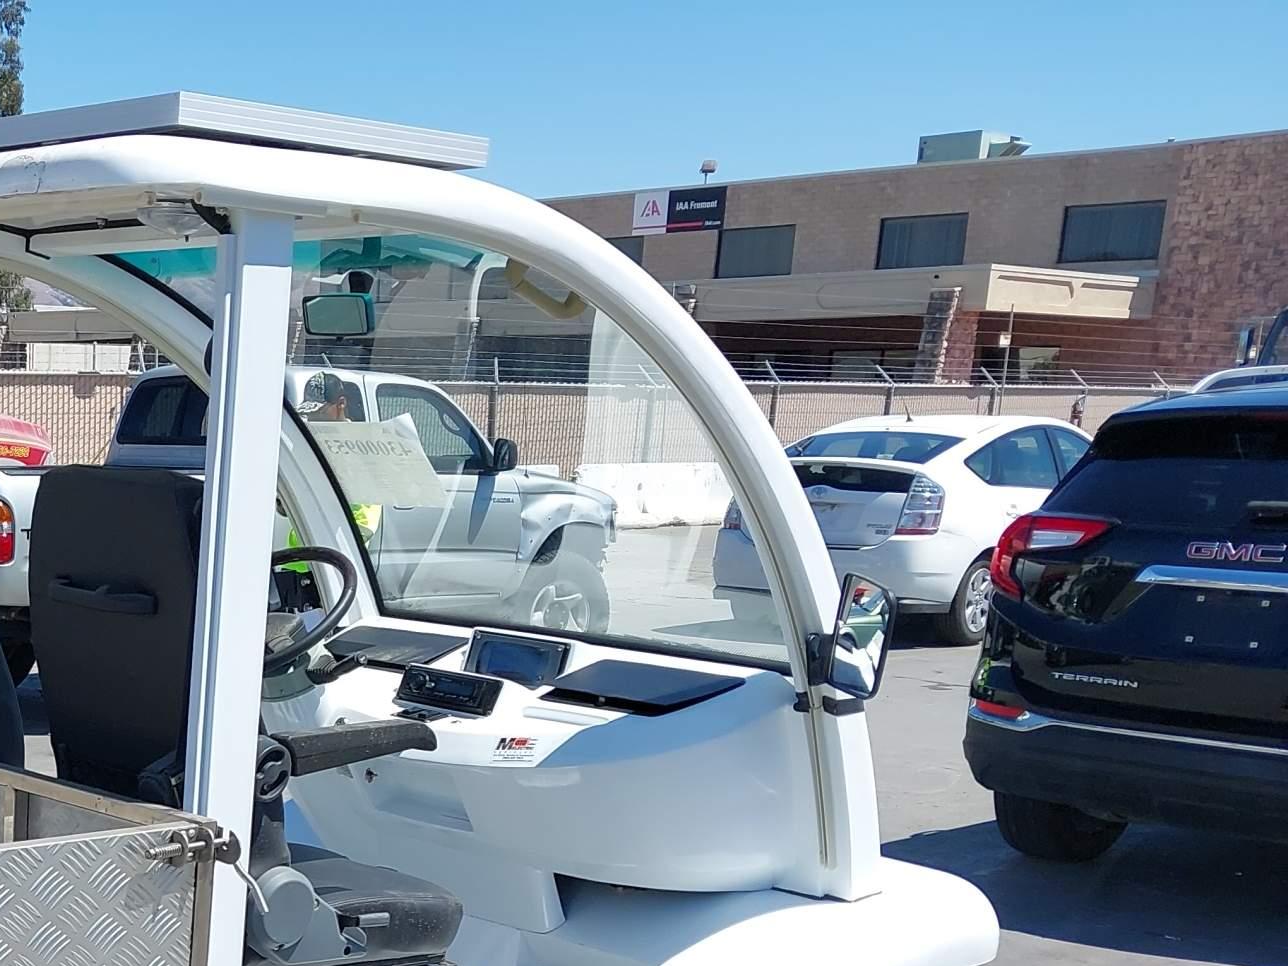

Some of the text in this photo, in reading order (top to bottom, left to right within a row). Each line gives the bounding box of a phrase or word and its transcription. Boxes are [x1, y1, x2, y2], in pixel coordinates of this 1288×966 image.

[676, 201, 689, 210] IAA
[1187, 541, 1287, 563] GMC
[1051, 672, 1139, 689] TERRAIN
